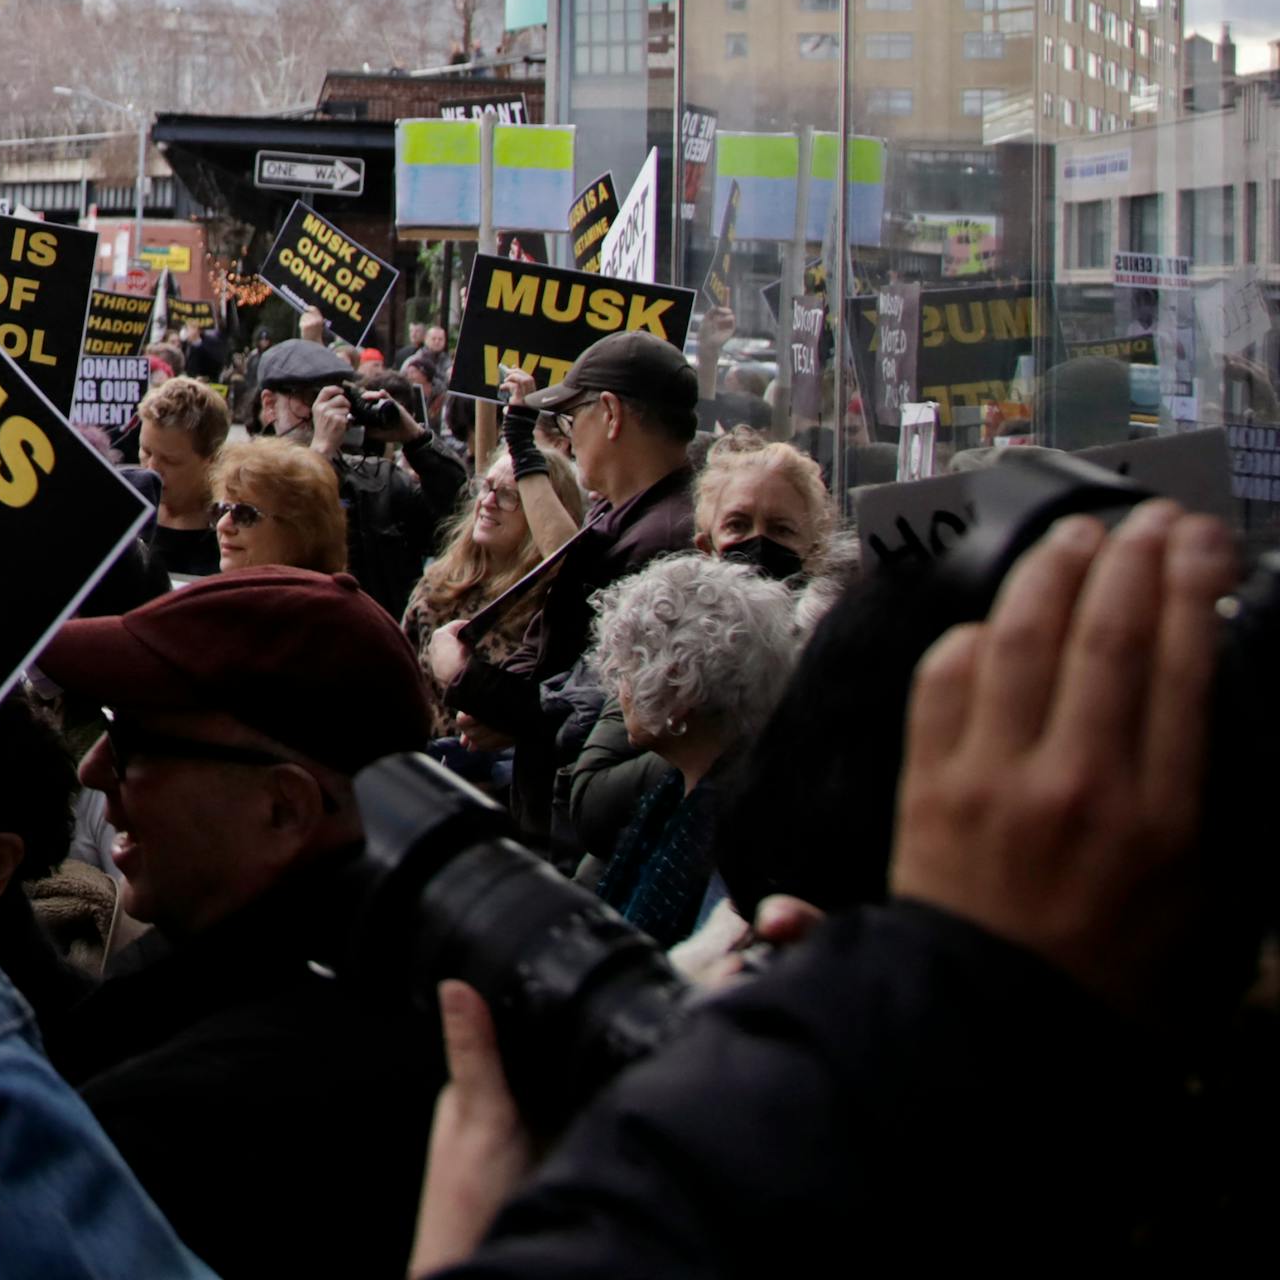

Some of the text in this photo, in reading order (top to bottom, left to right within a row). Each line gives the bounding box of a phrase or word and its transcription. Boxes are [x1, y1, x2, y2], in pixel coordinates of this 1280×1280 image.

[266, 162, 347, 180] ONE WAY
[10, 226, 59, 268] IS
[296, 236, 368, 294] OUT OF
[301, 212, 382, 281] MUSK IS
[278, 247, 364, 323] CONTROL
[485, 268, 676, 342] MUSK
[88, 315, 146, 334] HADOW
[85, 337, 134, 356] IDENT
[791, 343, 815, 377] TESLA
[81, 356, 149, 380] ONAIRE
[483, 343, 575, 389] WT
[101, 381, 141, 402] OUR
